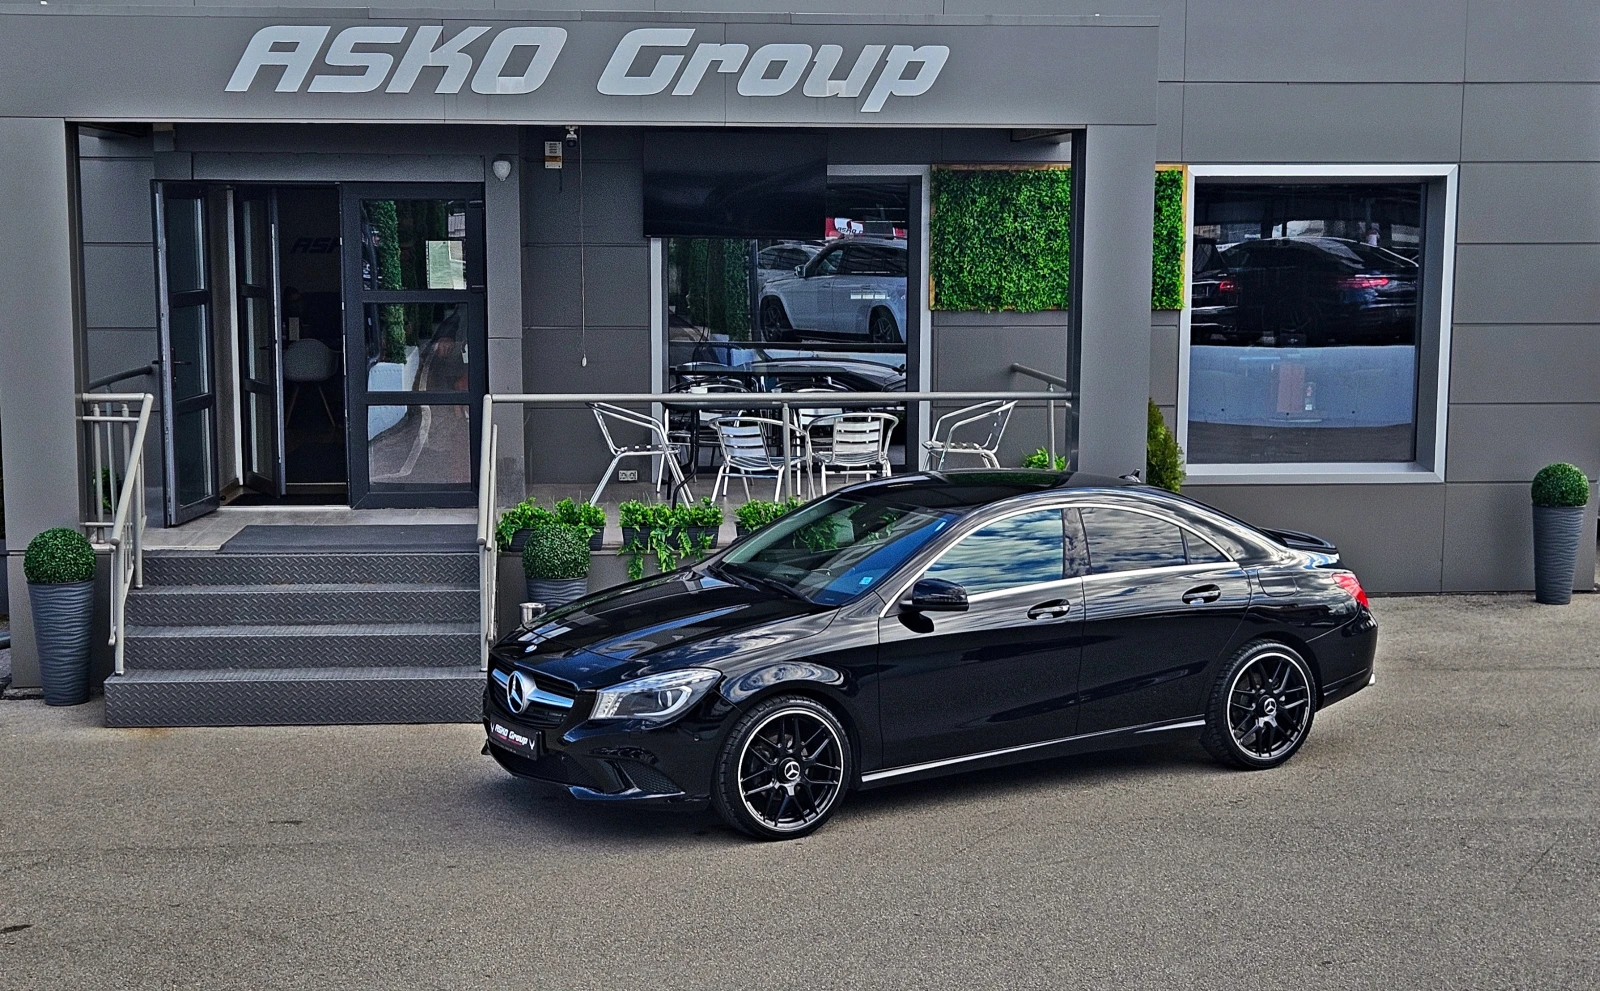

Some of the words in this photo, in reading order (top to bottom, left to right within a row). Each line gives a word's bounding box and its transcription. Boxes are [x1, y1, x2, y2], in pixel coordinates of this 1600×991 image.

[225, 25, 568, 95] ASKO
[596, 27, 950, 113] Group
[509, 731, 528, 745] Group
